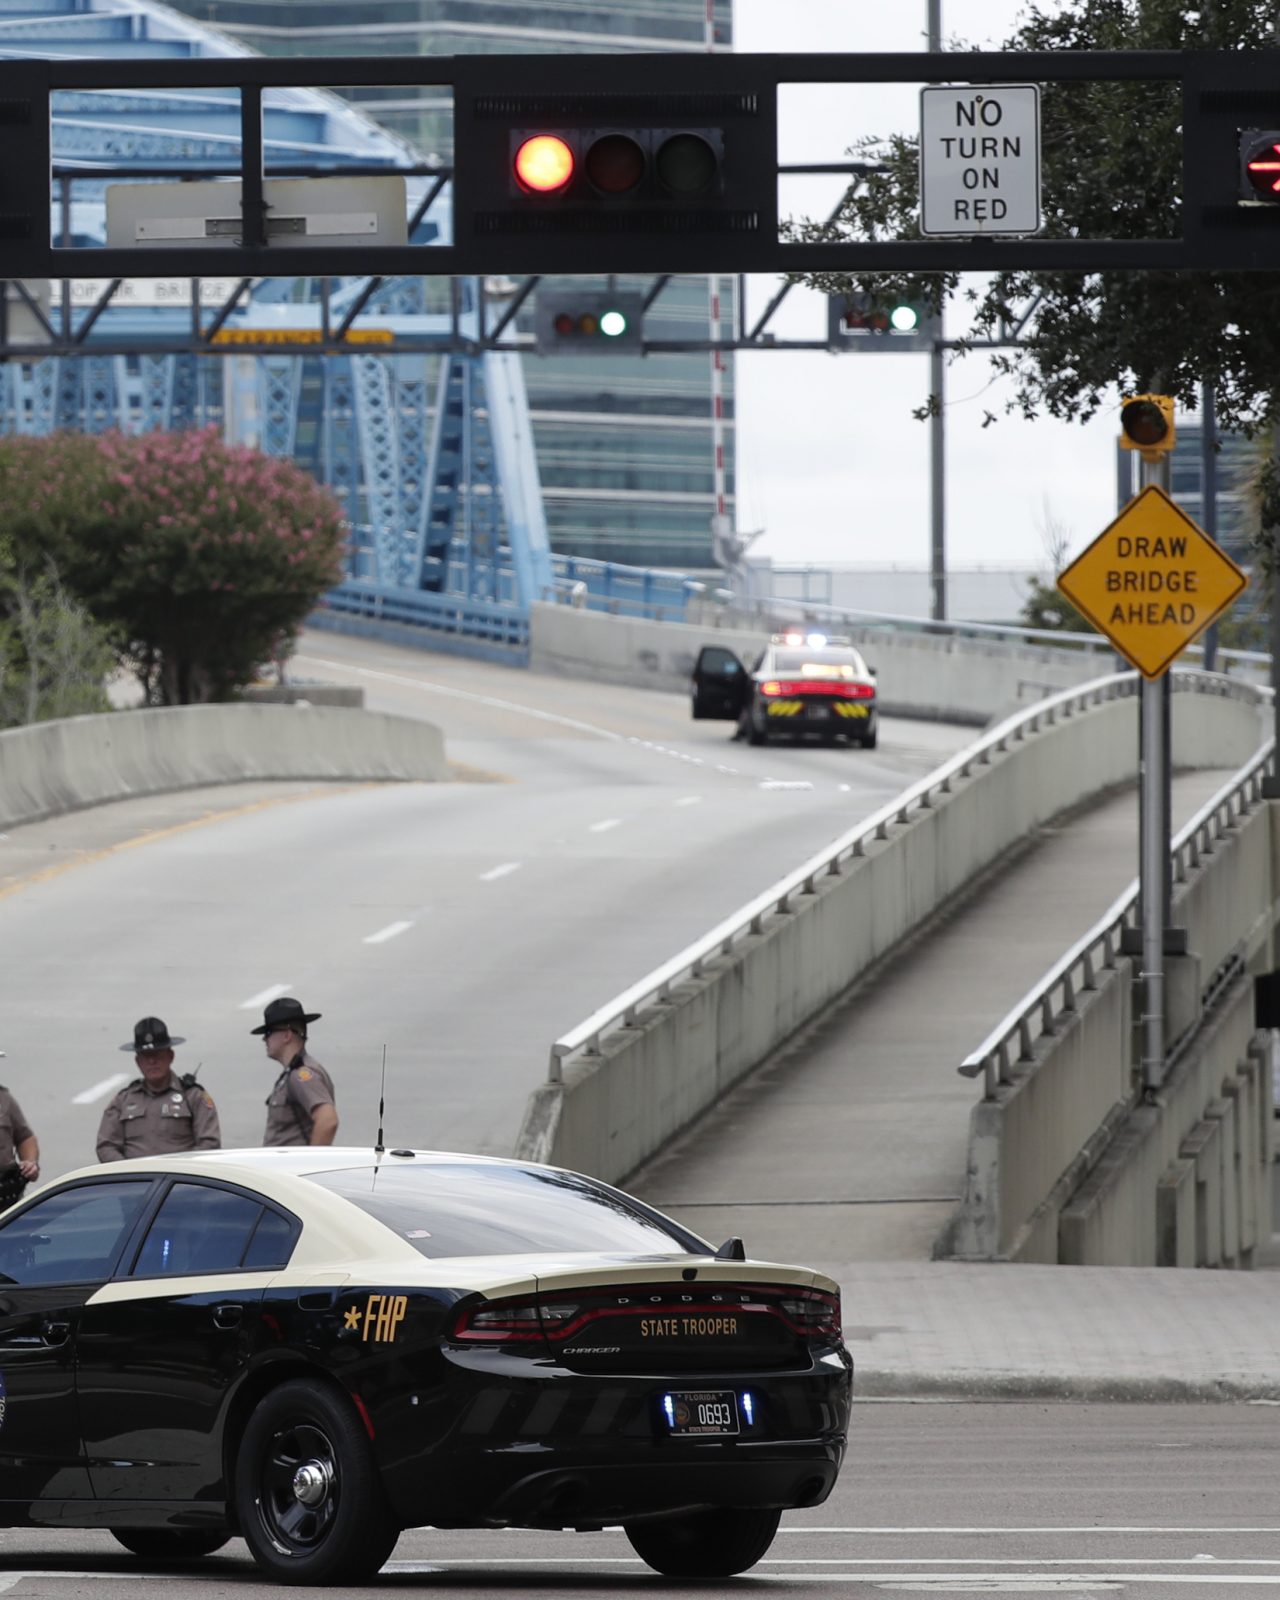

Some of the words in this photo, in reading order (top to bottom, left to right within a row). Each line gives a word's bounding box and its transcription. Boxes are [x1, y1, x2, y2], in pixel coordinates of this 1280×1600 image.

[956, 99, 1002, 127] NO
[940, 136, 1020, 159] TURN
[963, 168, 999, 189] ON
[954, 199, 1007, 221] RED
[153, 282, 226, 298] BRIGE
[1117, 537, 1187, 558] DRAW
[1106, 571, 1198, 592] BRIDGE
[1110, 603, 1196, 625] AHEAD
[618, 1295, 751, 1304] DODGE
[641, 1319, 679, 1337] STATE
[683, 1317, 738, 1336] TROOPER
[698, 1403, 731, 1425] 0693
